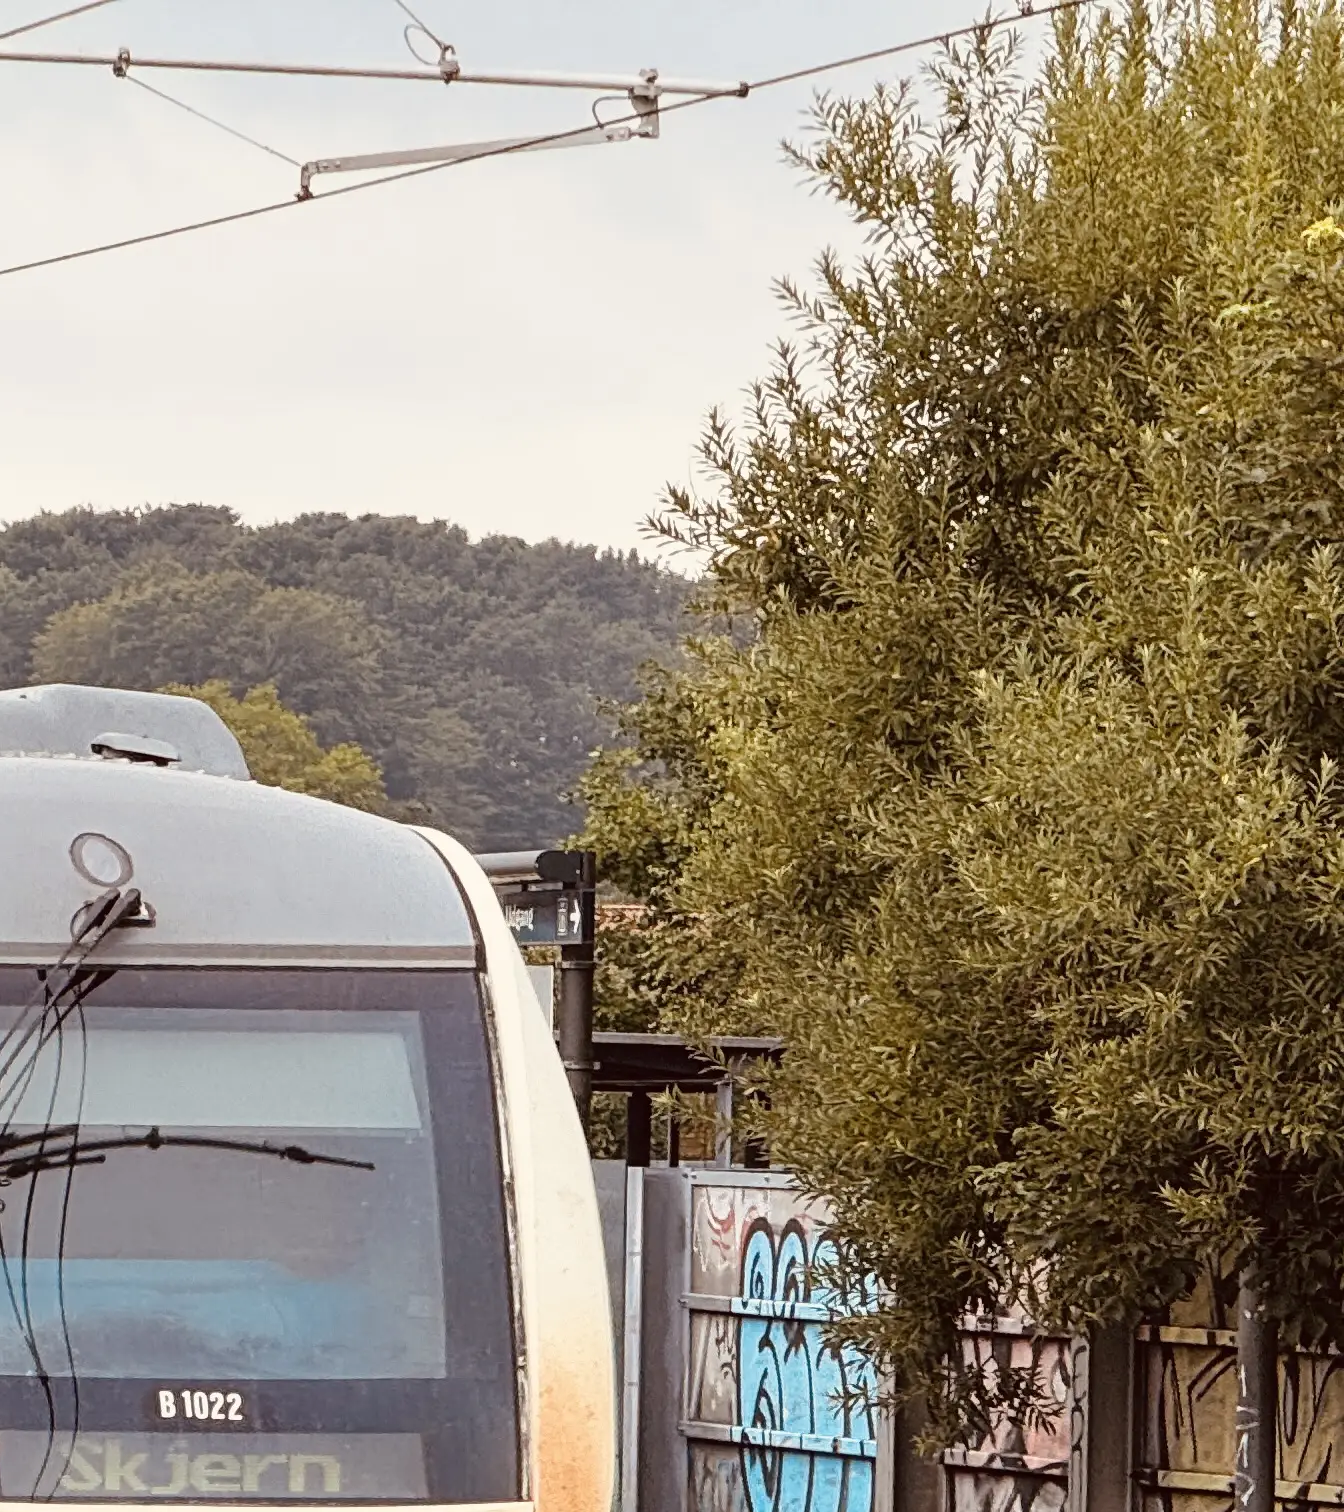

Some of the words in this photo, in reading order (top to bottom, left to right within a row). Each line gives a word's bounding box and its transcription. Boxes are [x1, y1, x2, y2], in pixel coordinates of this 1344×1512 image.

[158, 1390, 177, 1418] B
[181, 1390, 244, 1421] 1022
[59, 1438, 341, 1495] Skjern
